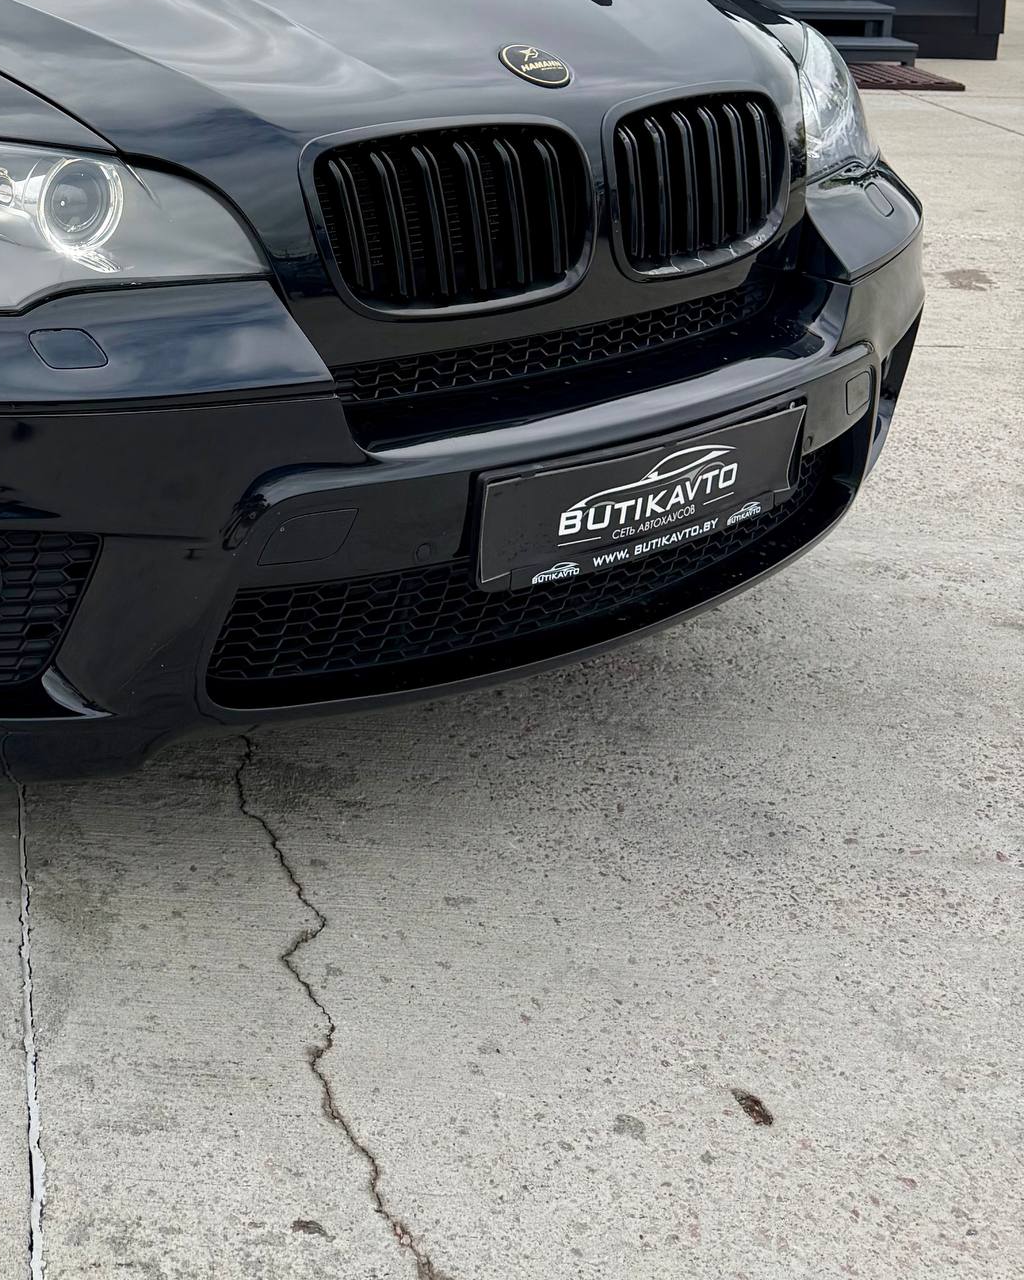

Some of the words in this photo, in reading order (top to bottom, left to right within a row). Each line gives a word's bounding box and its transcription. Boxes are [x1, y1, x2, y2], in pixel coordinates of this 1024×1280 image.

[520, 60, 562, 72] HAMANN
[558, 462, 738, 537] BUTIKAVTO
[612, 525, 636, 540] СЕТЬ
[637, 504, 696, 534] АВТОХАУСОВ
[727, 505, 762, 526] BUTIKAVTO
[593, 548, 630, 568] WWW.
[634, 517, 719, 556] BUTIKAVTO.BY
[531, 567, 580, 585] BUTIKAVTO
